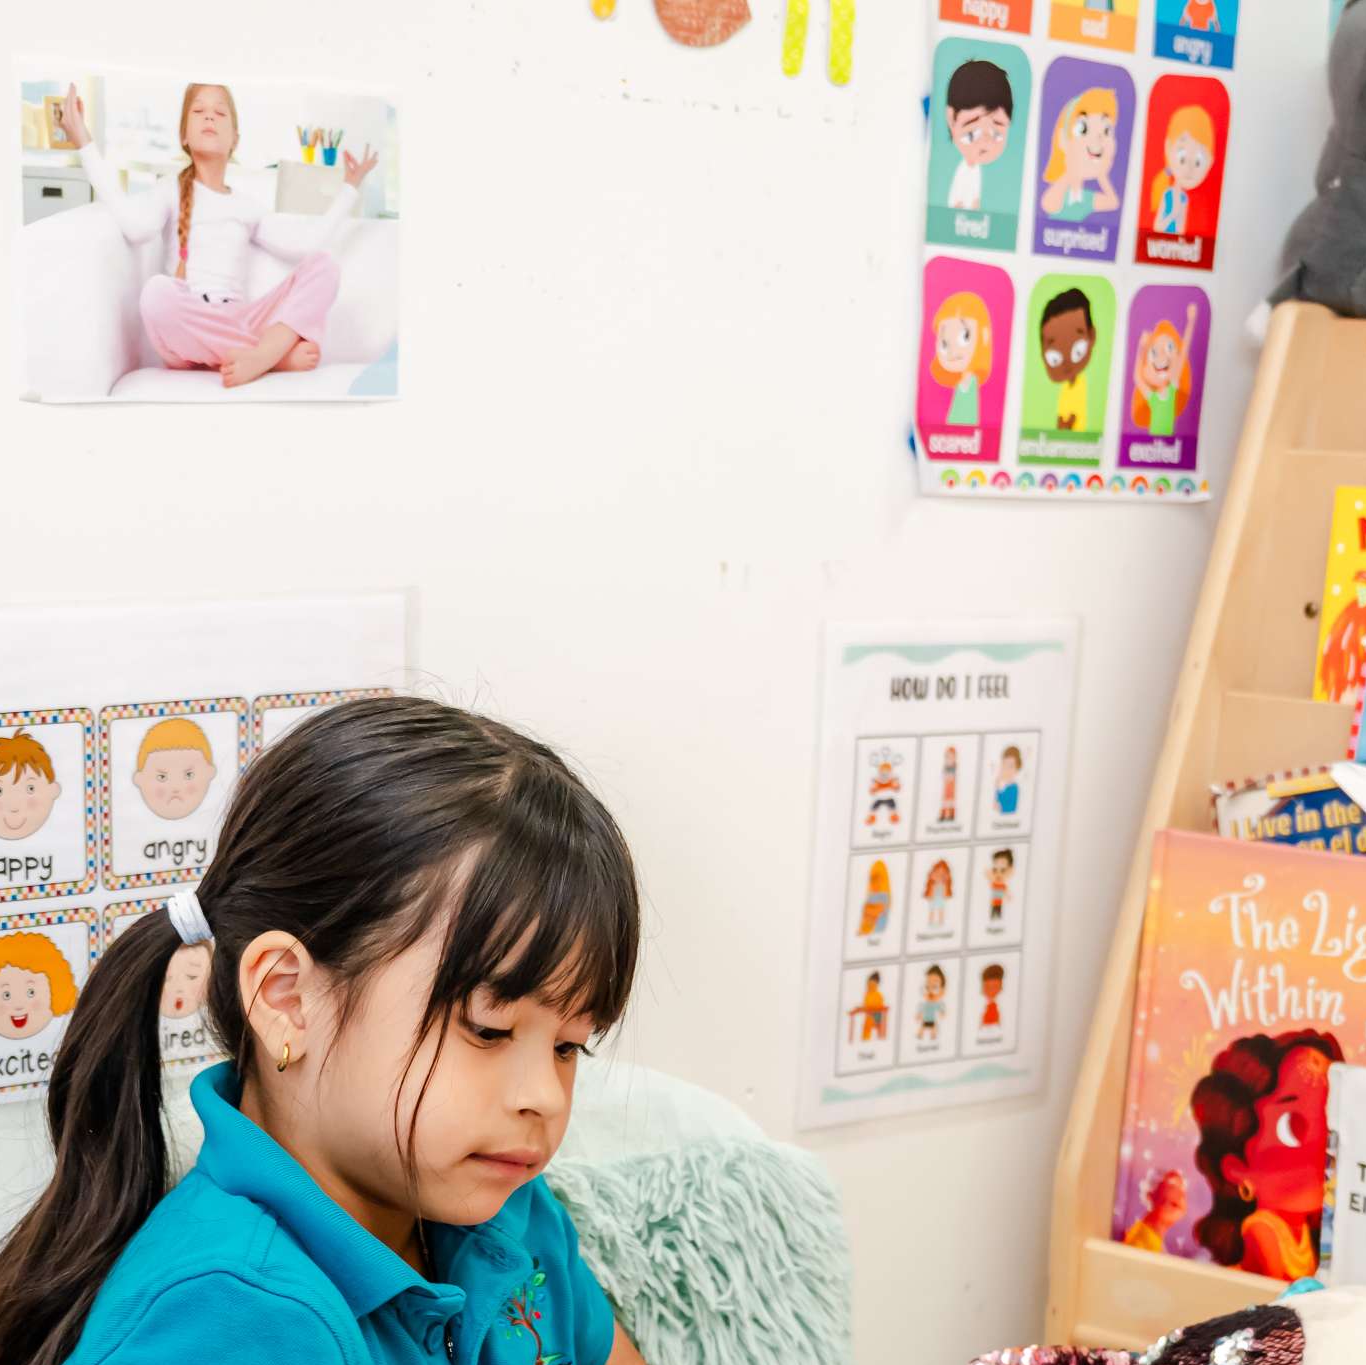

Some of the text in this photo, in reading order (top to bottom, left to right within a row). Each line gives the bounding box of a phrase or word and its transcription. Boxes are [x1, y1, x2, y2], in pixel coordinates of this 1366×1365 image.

[954, 214, 990, 240] tired
[1042, 226, 1109, 255] surprised
[1146, 235, 1202, 264] worried
[928, 429, 982, 455] scared
[1129, 438, 1182, 464] excited
[890, 673, 1011, 702] HOW DO I FEEL
[1295, 799, 1362, 833] in the
[143, 833, 209, 866] angry
[1208, 872, 1301, 954] The
[1178, 963, 1348, 1031] Within
